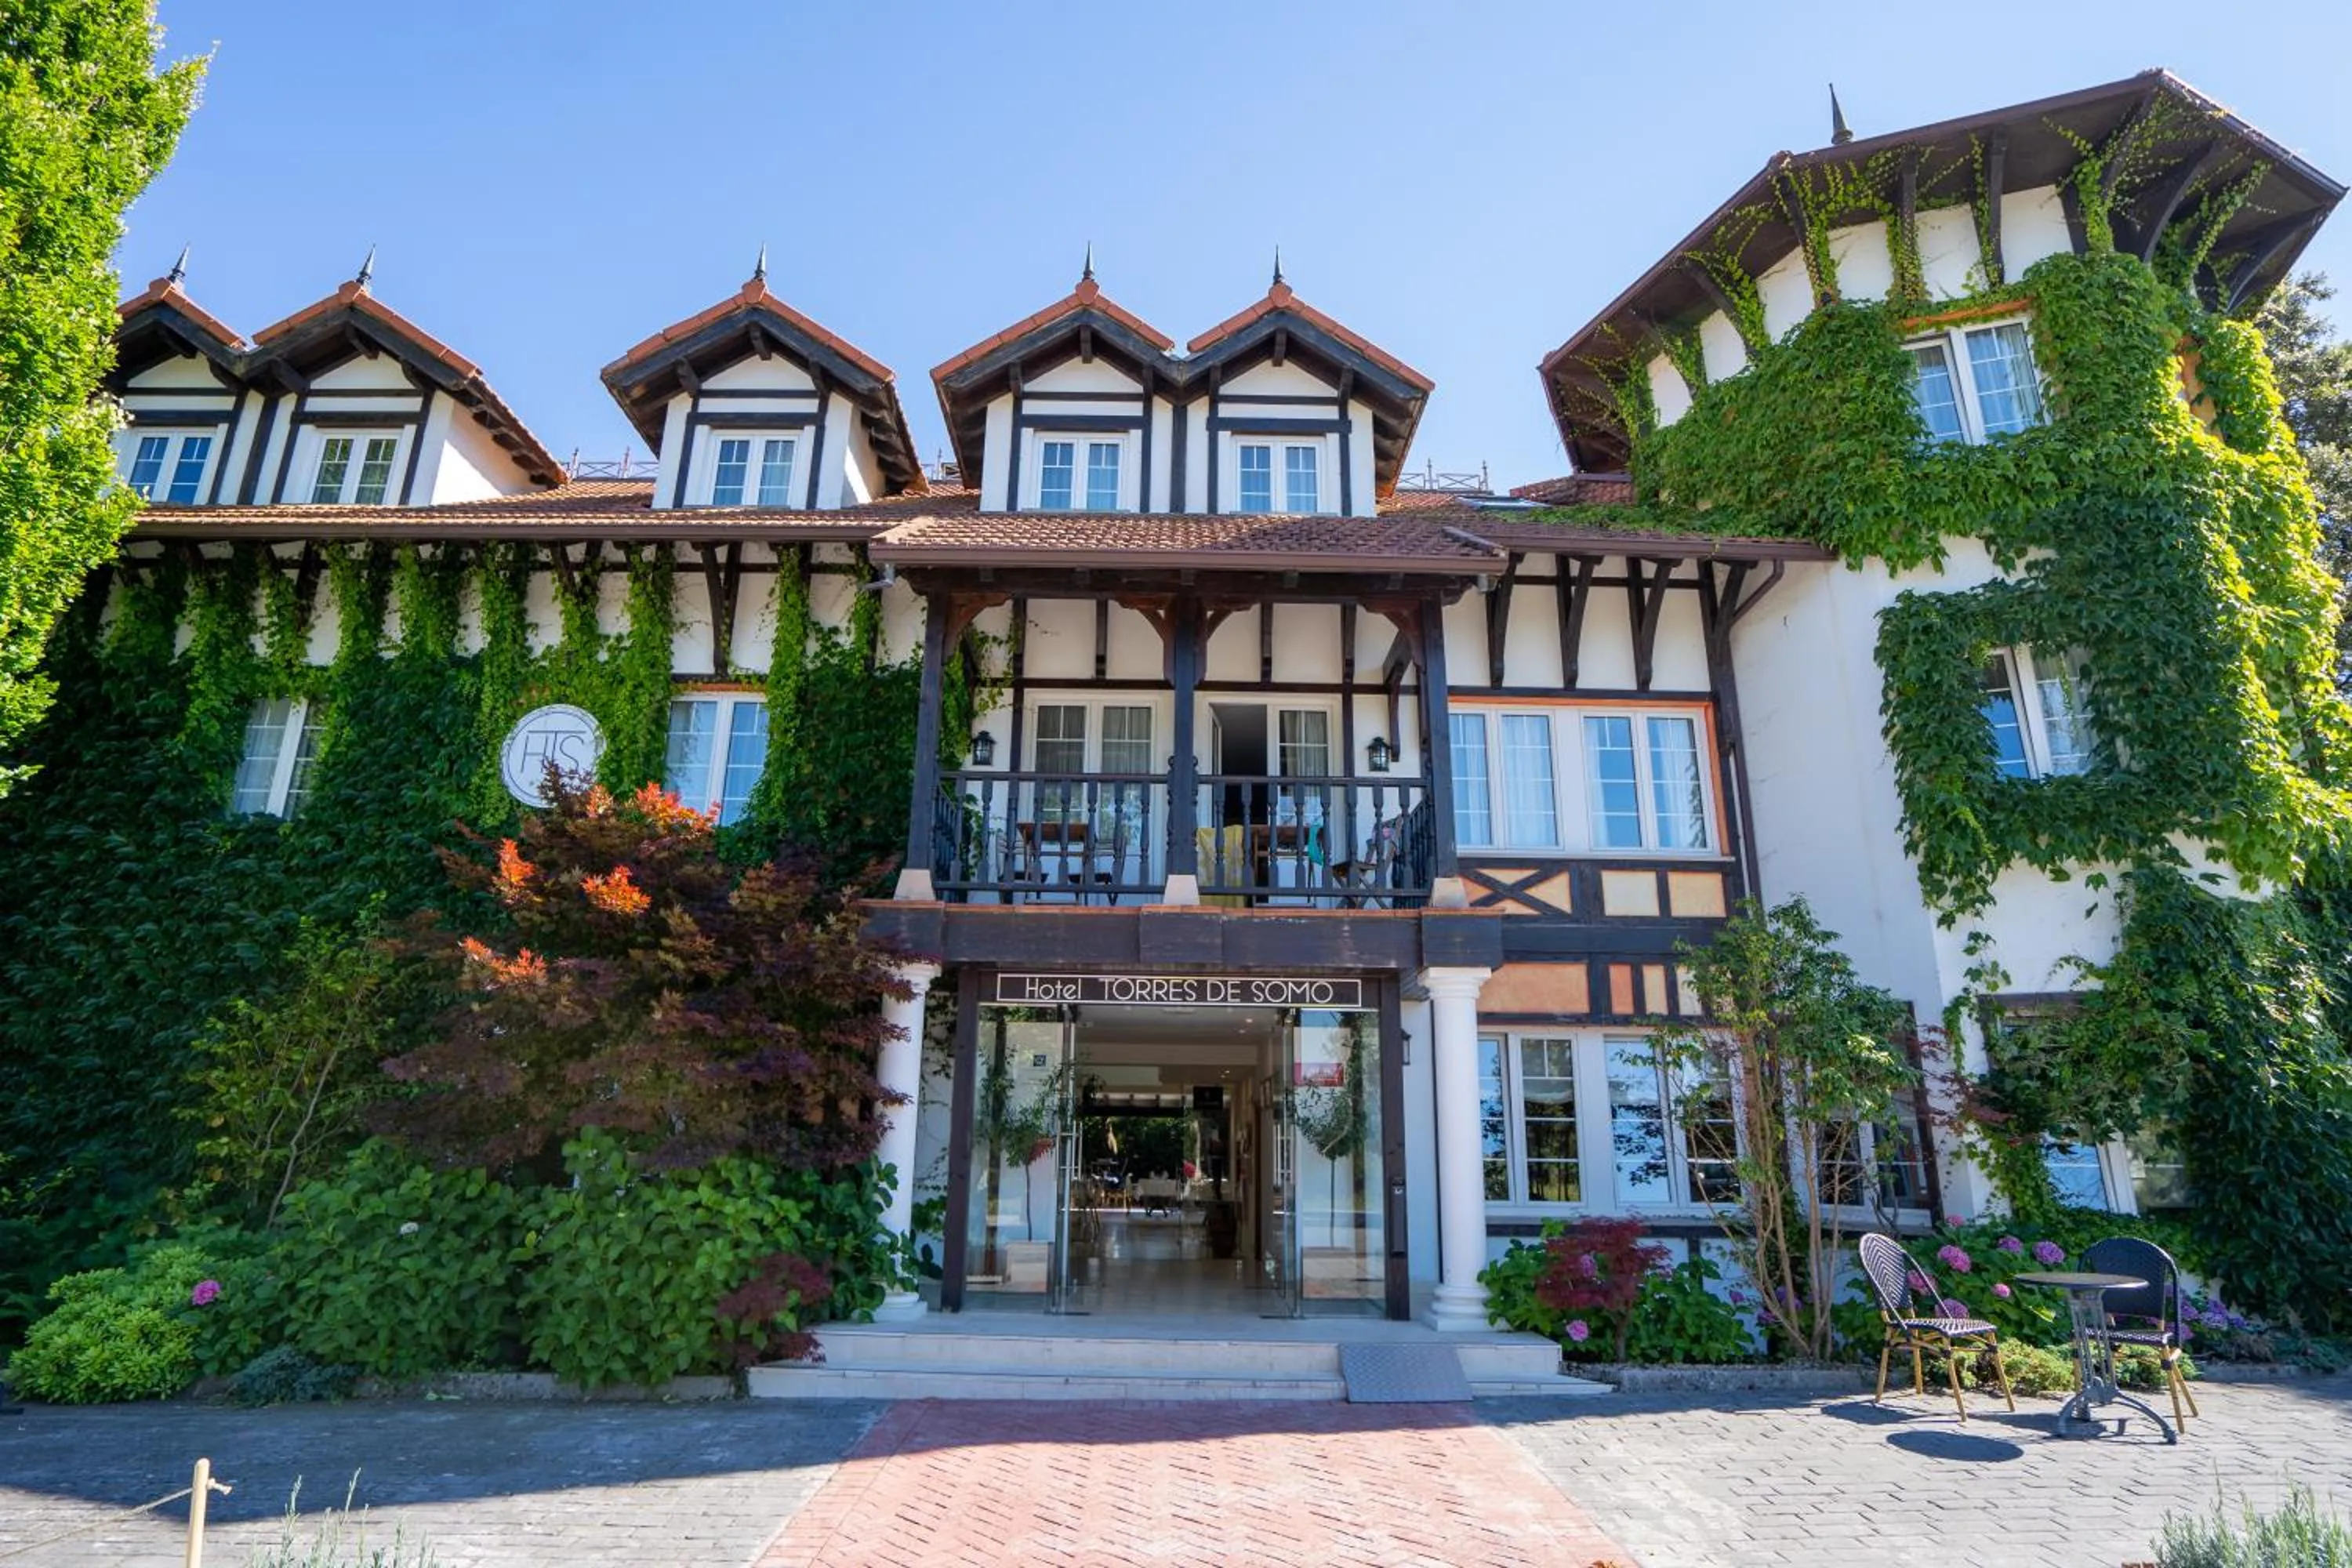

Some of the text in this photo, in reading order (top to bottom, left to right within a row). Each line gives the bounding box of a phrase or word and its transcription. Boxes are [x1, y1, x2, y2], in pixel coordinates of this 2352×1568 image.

[1025, 978, 1333, 1004] Hotel TORRES DE SOMO
